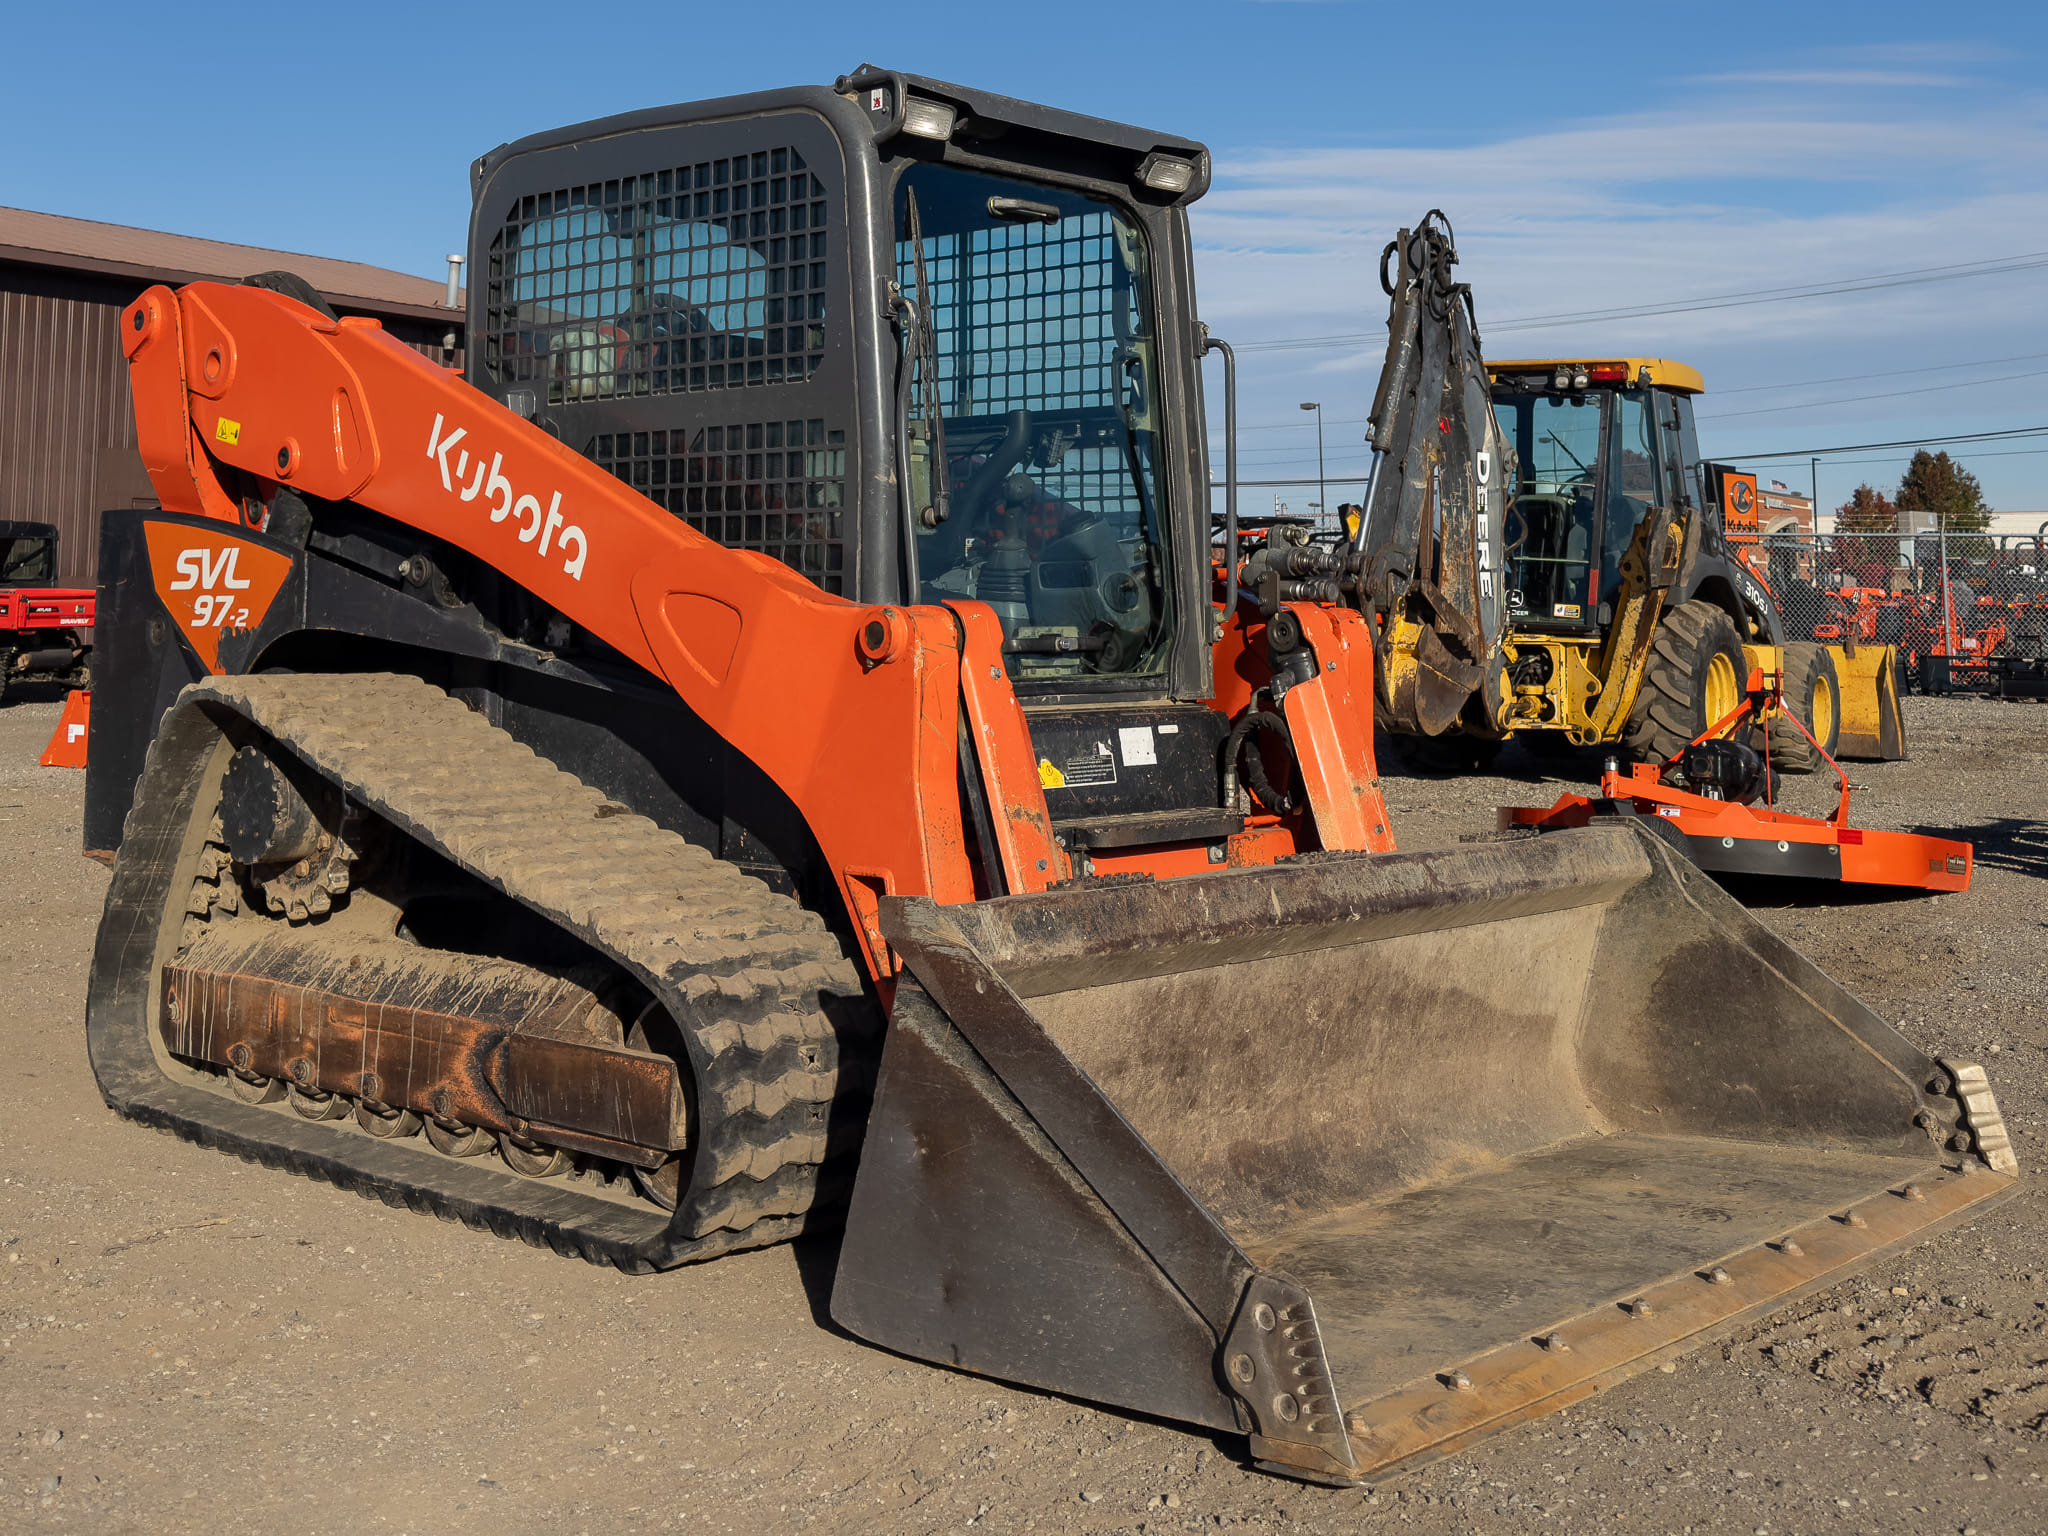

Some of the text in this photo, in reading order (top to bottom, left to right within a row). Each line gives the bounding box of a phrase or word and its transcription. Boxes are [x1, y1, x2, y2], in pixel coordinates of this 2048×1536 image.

[426, 412, 588, 582] Kubota
[1476, 451, 1493, 600] DEERE
[170, 547, 251, 591] SVL
[190, 594, 250, 627] 97-2
[1745, 580, 1768, 615] 310SJ
